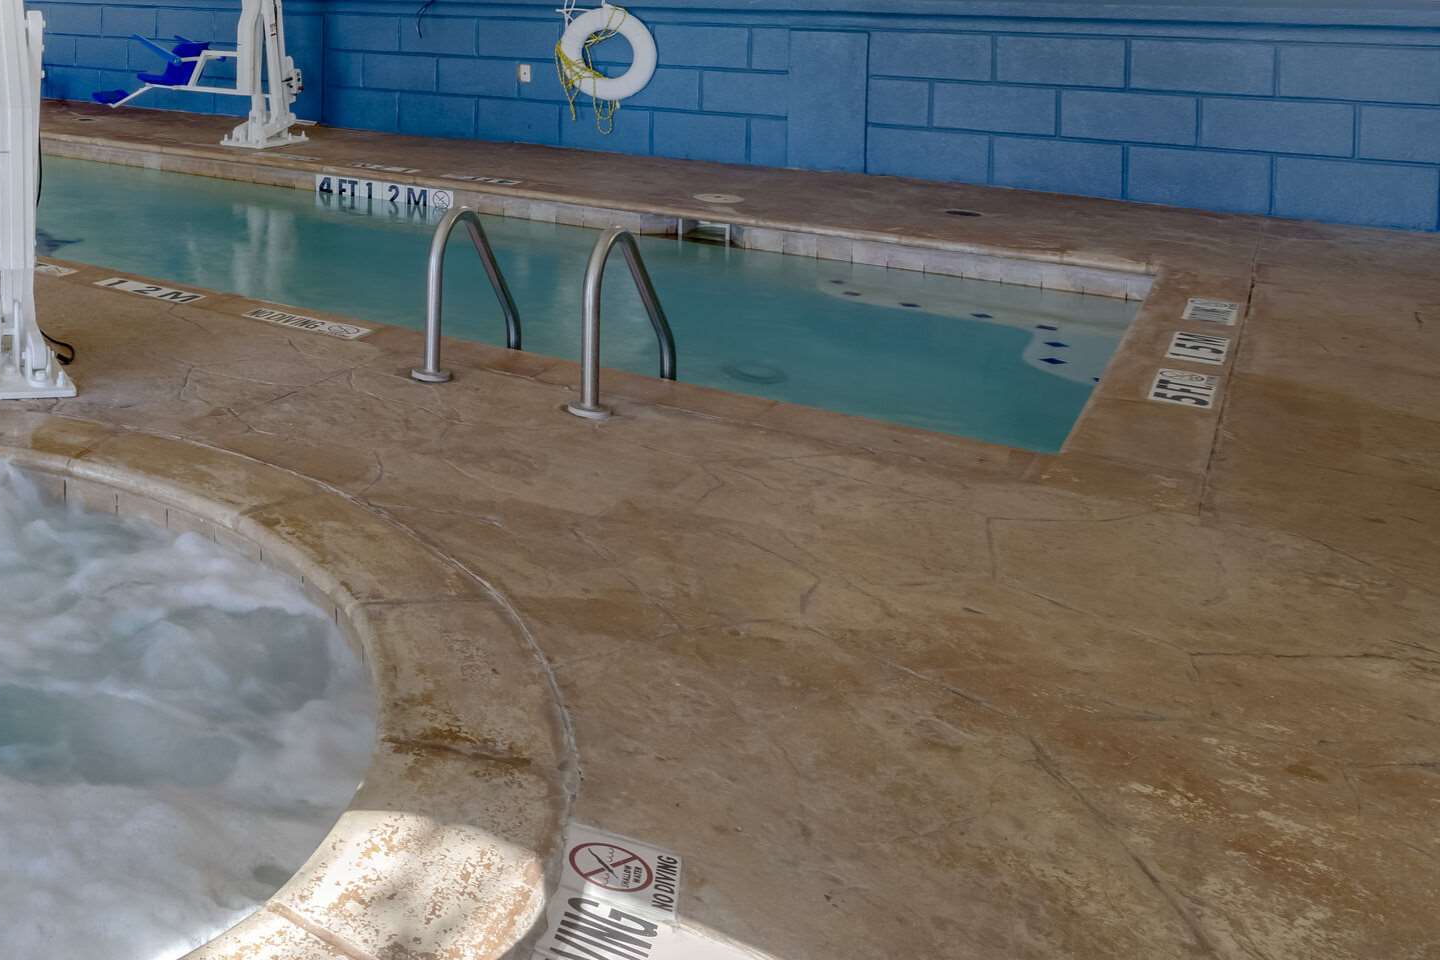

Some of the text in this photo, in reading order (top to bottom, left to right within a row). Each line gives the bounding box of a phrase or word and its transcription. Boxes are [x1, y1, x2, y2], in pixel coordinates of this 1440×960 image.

[318, 176, 333, 193] 4
[338, 179, 358, 197] FT
[264, 313, 325, 330] DIVING
[652, 855, 678, 912] NO DIVING
